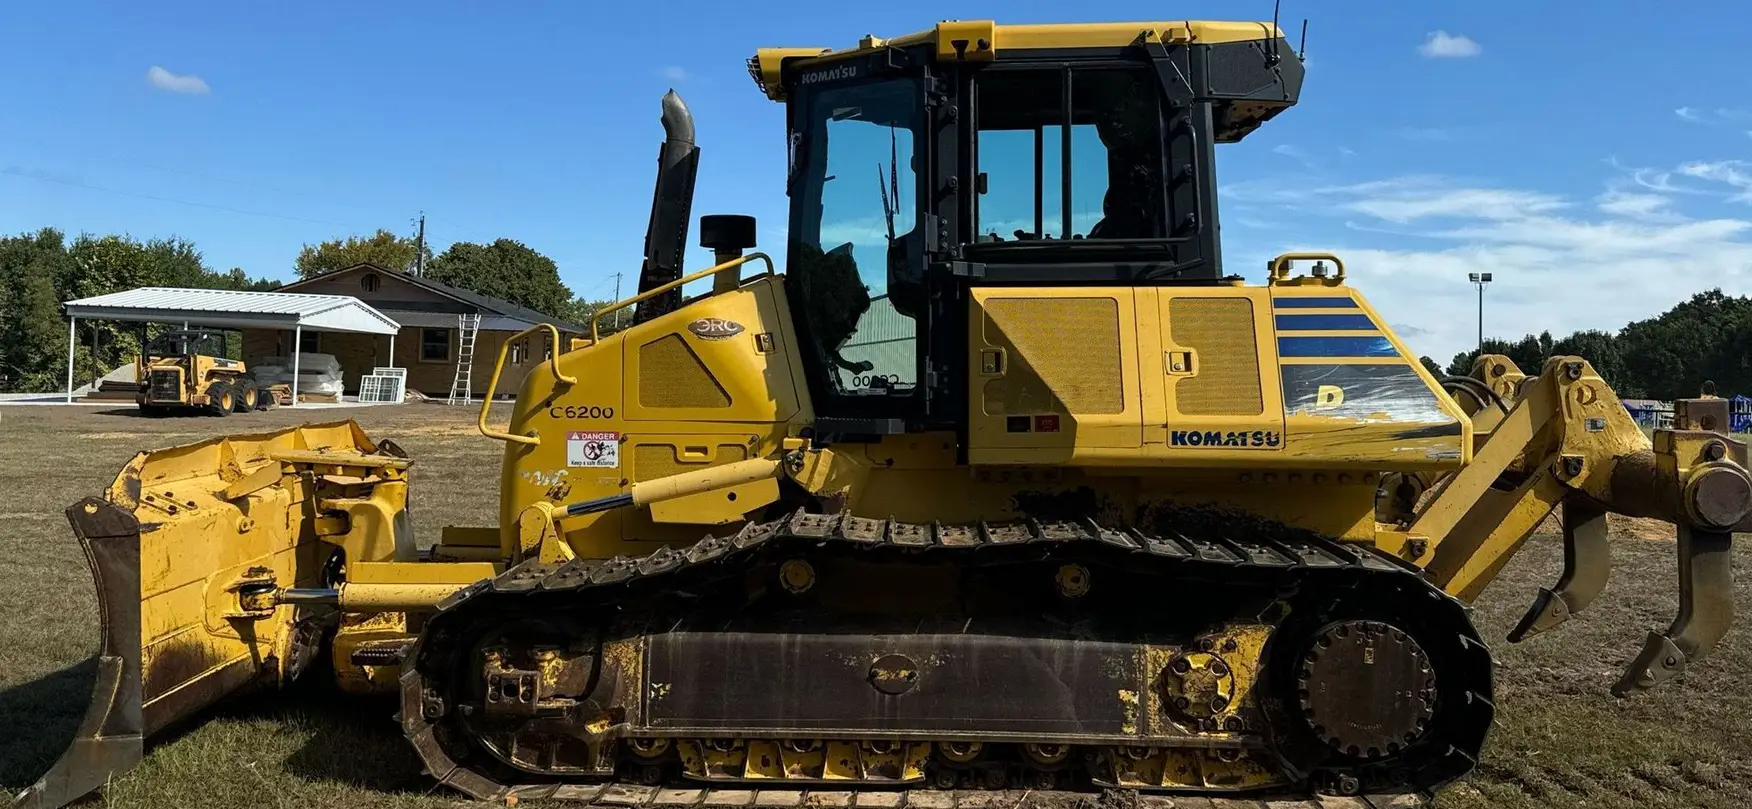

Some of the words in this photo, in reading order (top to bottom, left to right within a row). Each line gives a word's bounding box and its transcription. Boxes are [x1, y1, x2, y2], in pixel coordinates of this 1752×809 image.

[801, 65, 857, 84] KOMATSU
[550, 406, 614, 419] C6200
[581, 432, 615, 440] DANGER
[1171, 430, 1280, 446] KOMATSU
